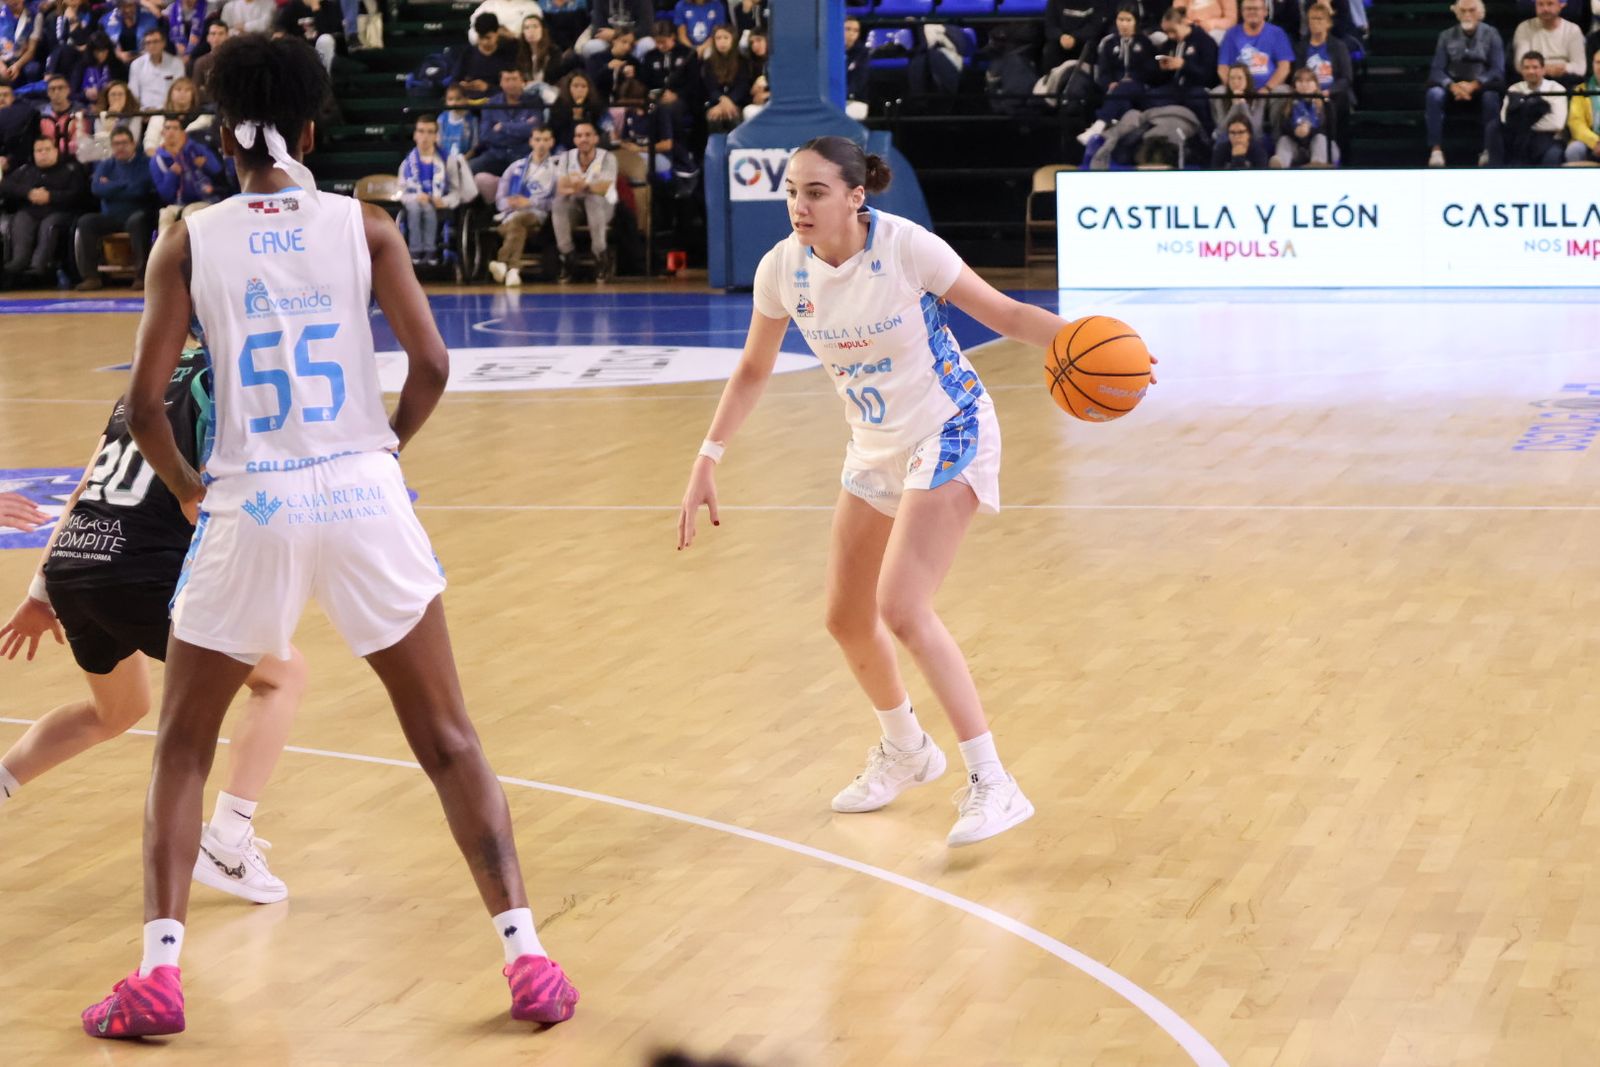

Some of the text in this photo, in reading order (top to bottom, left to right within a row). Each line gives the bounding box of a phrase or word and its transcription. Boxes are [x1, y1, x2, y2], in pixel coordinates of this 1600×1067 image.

[1077, 194, 1379, 234] CASTILLA Y LEÓN
[248, 228, 305, 254] CAVE
[1157, 240, 1297, 261] NOS IMPULSA
[1524, 238, 1562, 253] NOS
[253, 290, 332, 312] avenida
[854, 326, 863, 338] Y
[867, 314, 903, 335] LEÓN
[238, 322, 346, 434] 55
[846, 386, 886, 424] 10
[79, 437, 156, 507] 20
[286, 486, 385, 510] CAJA RURAL
[288, 505, 388, 525] DE SALAMANCA
[91, 553, 112, 562] FORMA
